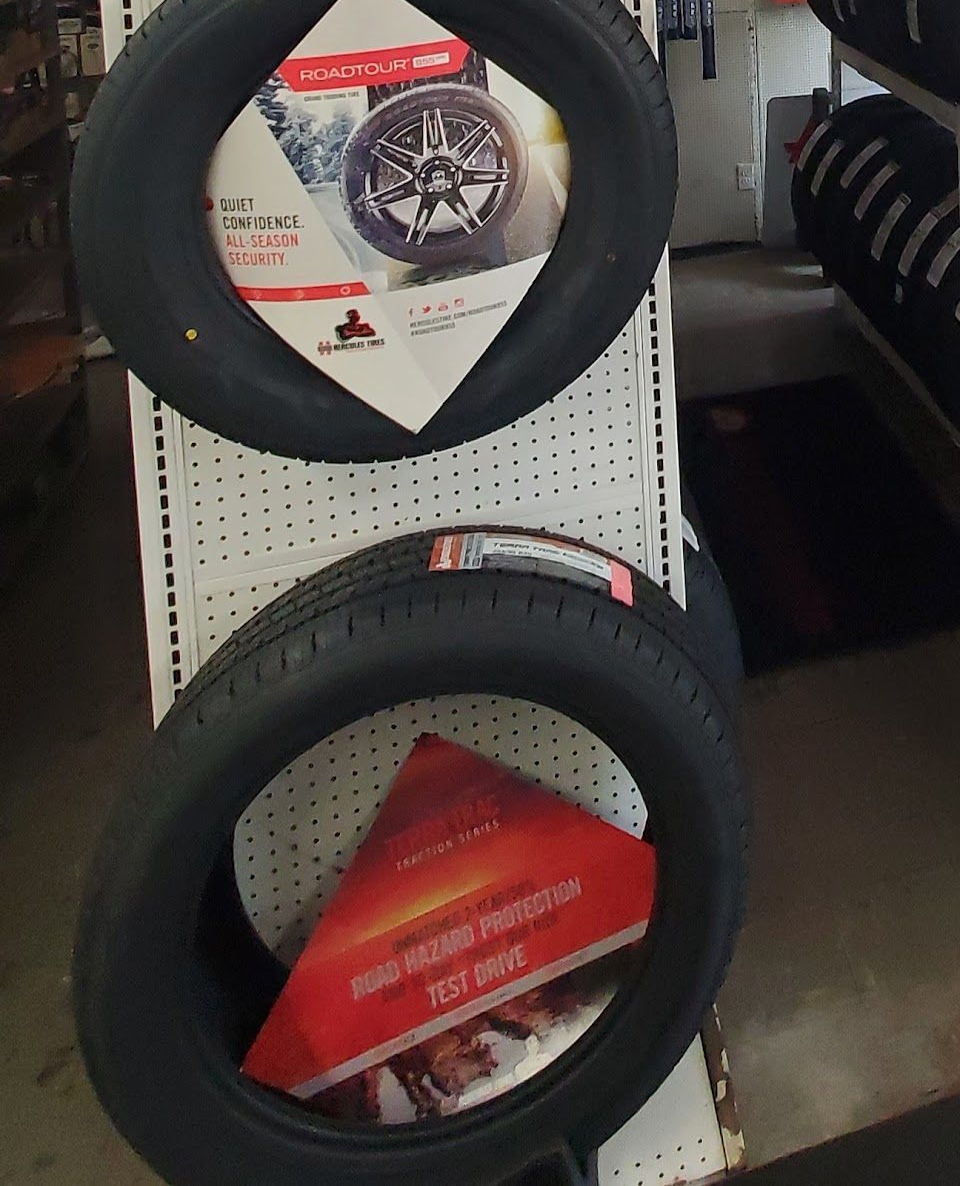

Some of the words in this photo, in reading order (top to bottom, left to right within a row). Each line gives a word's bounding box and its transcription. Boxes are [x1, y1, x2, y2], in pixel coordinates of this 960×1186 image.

[300, 59, 407, 82] ROADTOUR
[220, 198, 254, 212] QUIET
[223, 214, 305, 230] CONFIDENCE.
[226, 233, 299, 248] ALL-SEASON
[228, 251, 289, 266] SECURITY.
[351, 960, 400, 1000] ROAD
[404, 924, 475, 974] HAZARD
[480, 876, 582, 938] PROTECTION
[426, 971, 470, 1009] TEST
[474, 945, 528, 988] DRIVE
